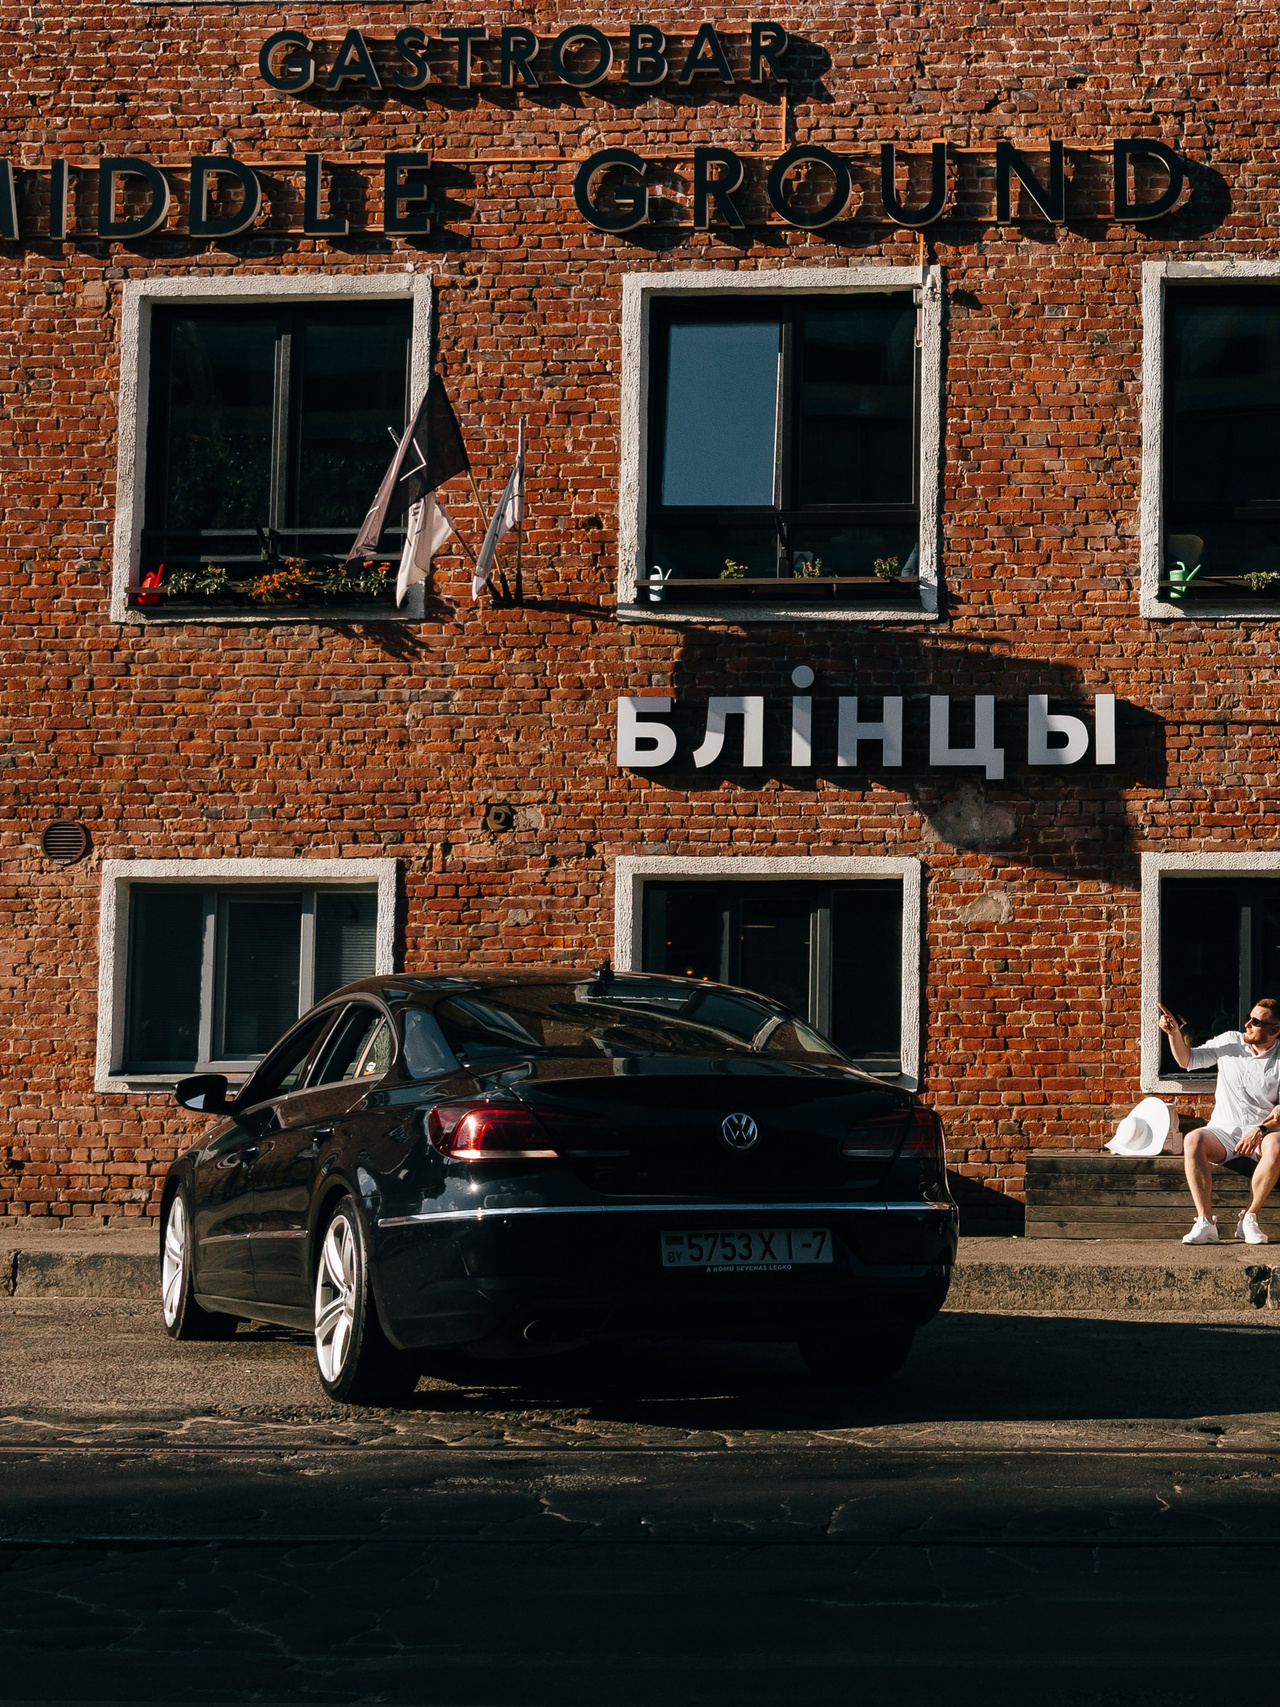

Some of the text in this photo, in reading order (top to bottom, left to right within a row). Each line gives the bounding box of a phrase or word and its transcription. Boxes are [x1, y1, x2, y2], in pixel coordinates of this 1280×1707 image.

[259, 21, 789, 94] GASTROBAR
[573, 138, 1185, 233] GROUND
[668, 1251, 683, 1263] BY
[687, 1231, 753, 1263] 5753
